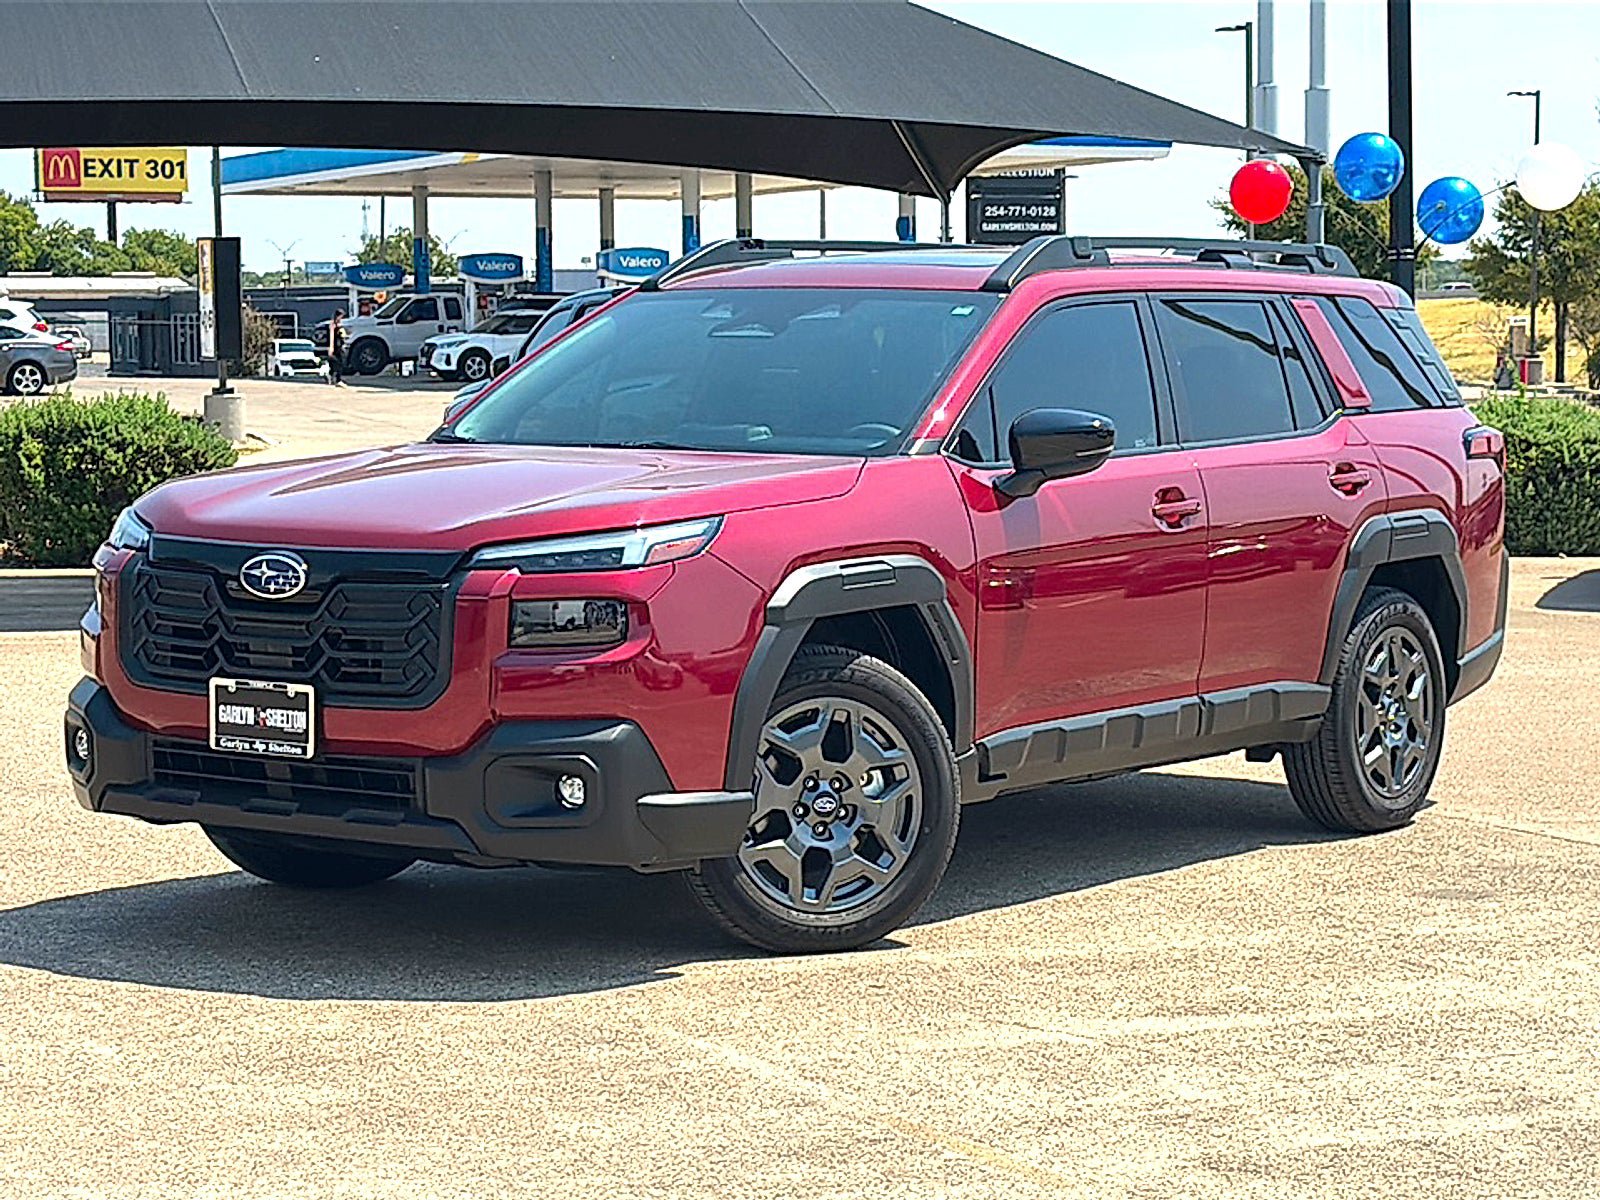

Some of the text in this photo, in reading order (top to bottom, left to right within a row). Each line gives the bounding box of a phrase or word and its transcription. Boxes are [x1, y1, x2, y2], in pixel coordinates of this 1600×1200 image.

[83, 158, 185, 179] EXIT 301
[984, 205, 1056, 217] 254-771-0128
[476, 260, 516, 271] Valero
[620, 256, 661, 268] Valero
[359, 270, 396, 280] Valero
[218, 704, 306, 729] GARLYN SHELTON
